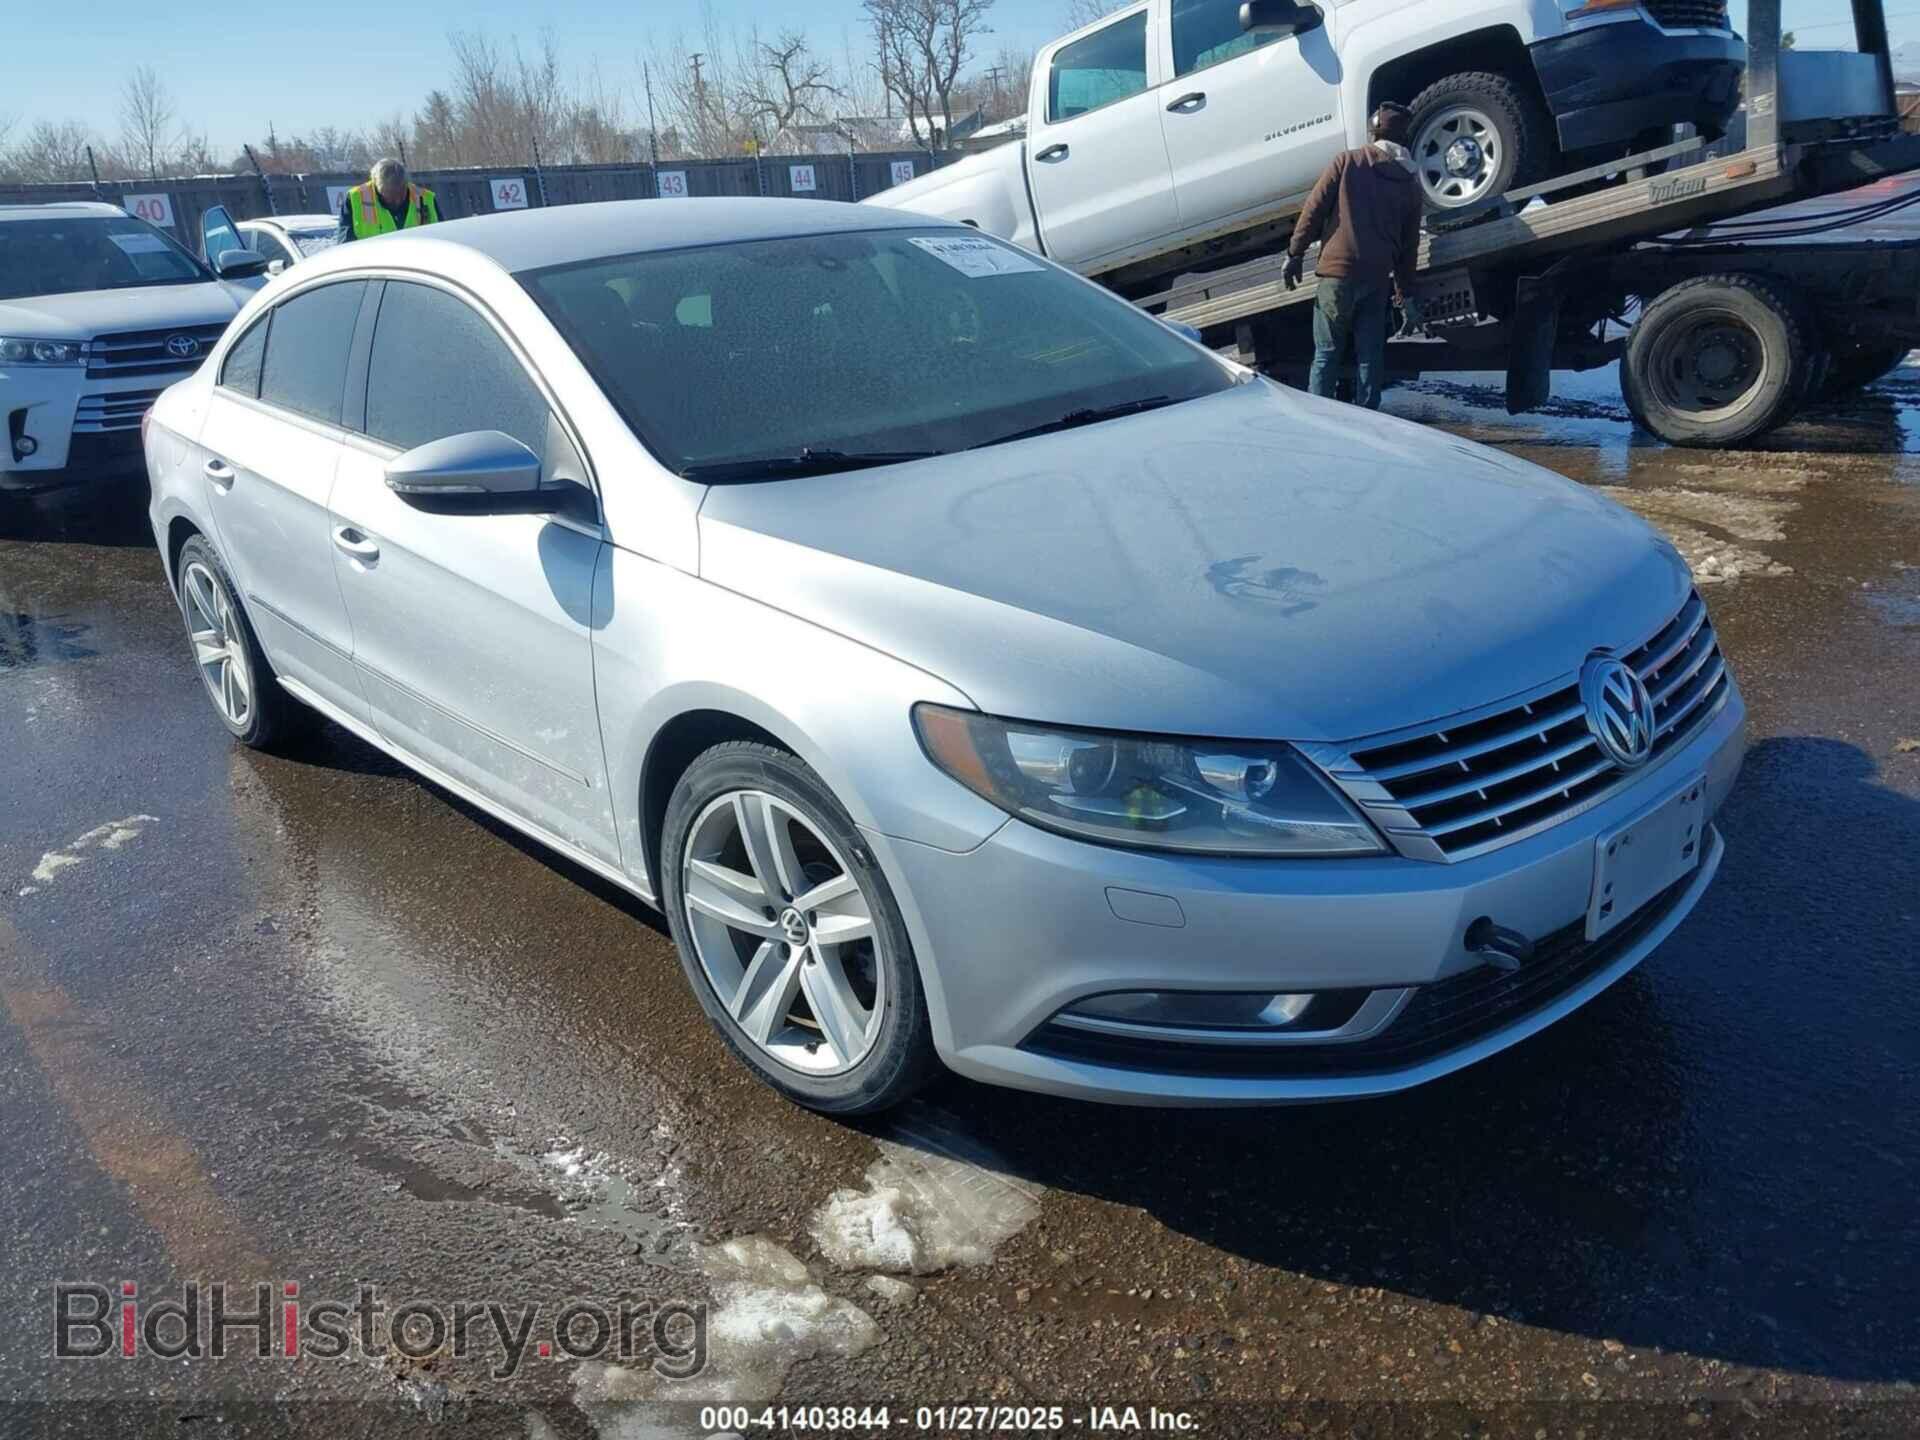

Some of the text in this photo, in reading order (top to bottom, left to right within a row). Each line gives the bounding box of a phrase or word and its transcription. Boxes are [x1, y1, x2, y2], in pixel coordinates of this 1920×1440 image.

[795, 170, 811, 186] 44
[896, 165, 912, 182] 45
[498, 183, 522, 203] 42
[663, 175, 682, 194] 43
[136, 199, 165, 221] 40
